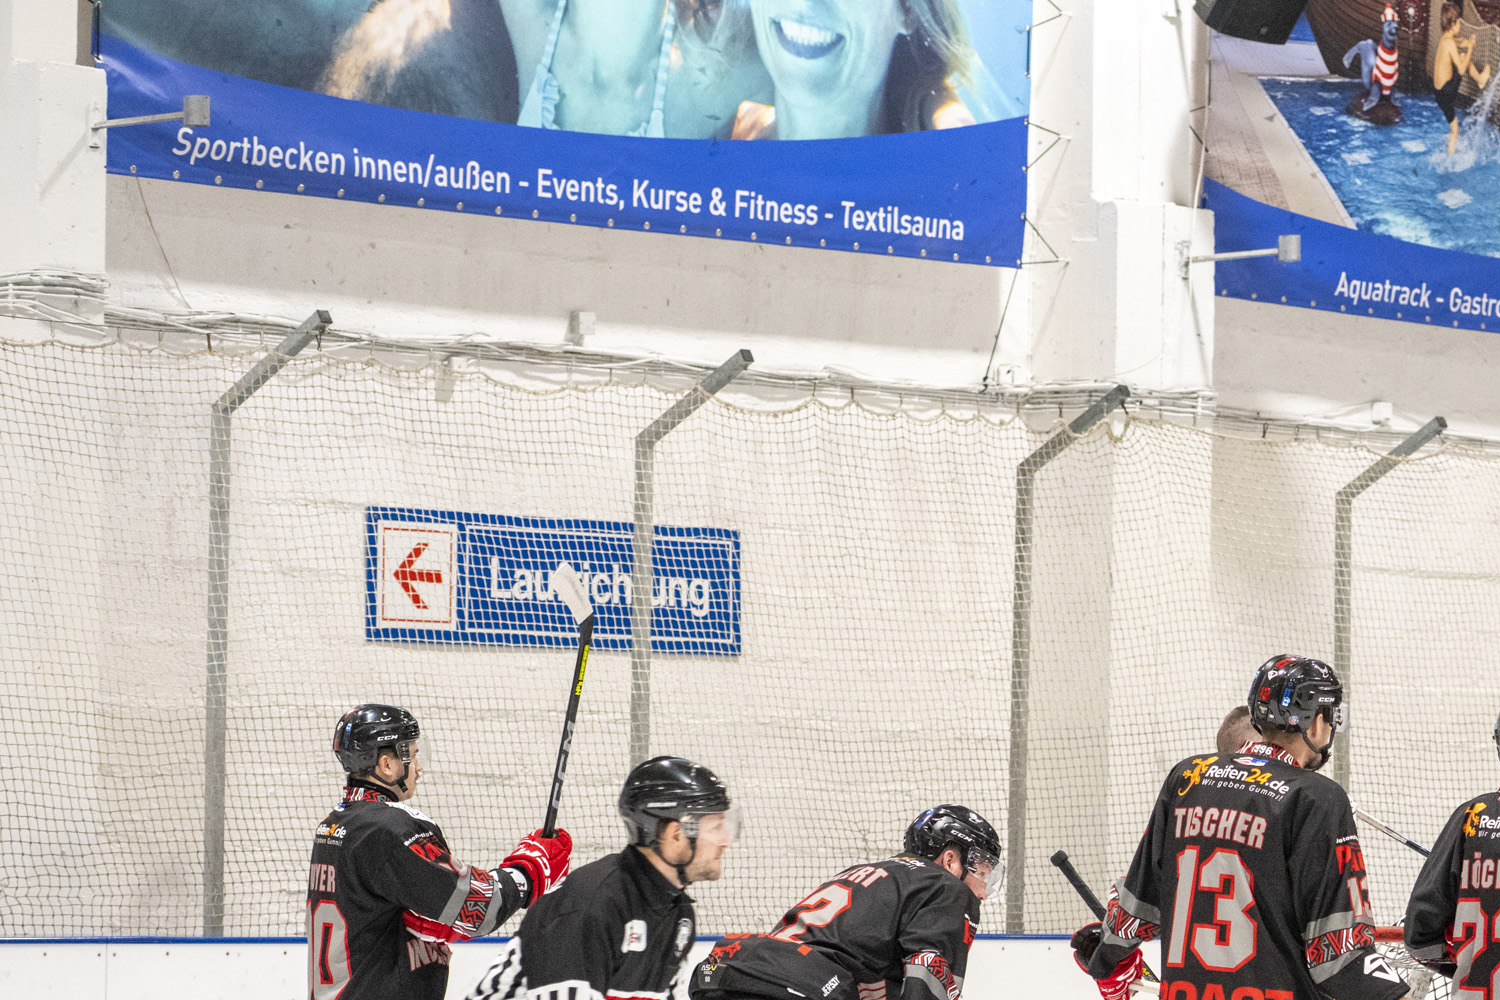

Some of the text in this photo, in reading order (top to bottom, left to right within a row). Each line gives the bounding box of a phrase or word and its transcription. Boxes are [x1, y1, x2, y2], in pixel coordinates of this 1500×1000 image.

[172, 127, 346, 176] Sportbecken
[353, 148, 511, 193] innen/außen
[537, 168, 625, 211] Events,
[632, 179, 702, 214] Kurse
[709, 187, 727, 217] &
[734, 190, 819, 226] Fitness
[841, 200, 965, 241] Textilsauna
[1334, 271, 1430, 308] Aquatrack
[490, 557, 710, 618] Lauichung
[552, 720, 575, 809] CCM
[1251, 742, 1273, 756] 1996
[1202, 778, 1285, 802] Wir geben Gummi!
[1205, 764, 1290, 795] Reifen24.de
[950, 829, 972, 842] CCM
[1174, 805, 1268, 849] TISCHER
[1336, 844, 1366, 874] PAU
[1166, 845, 1257, 973] 13
